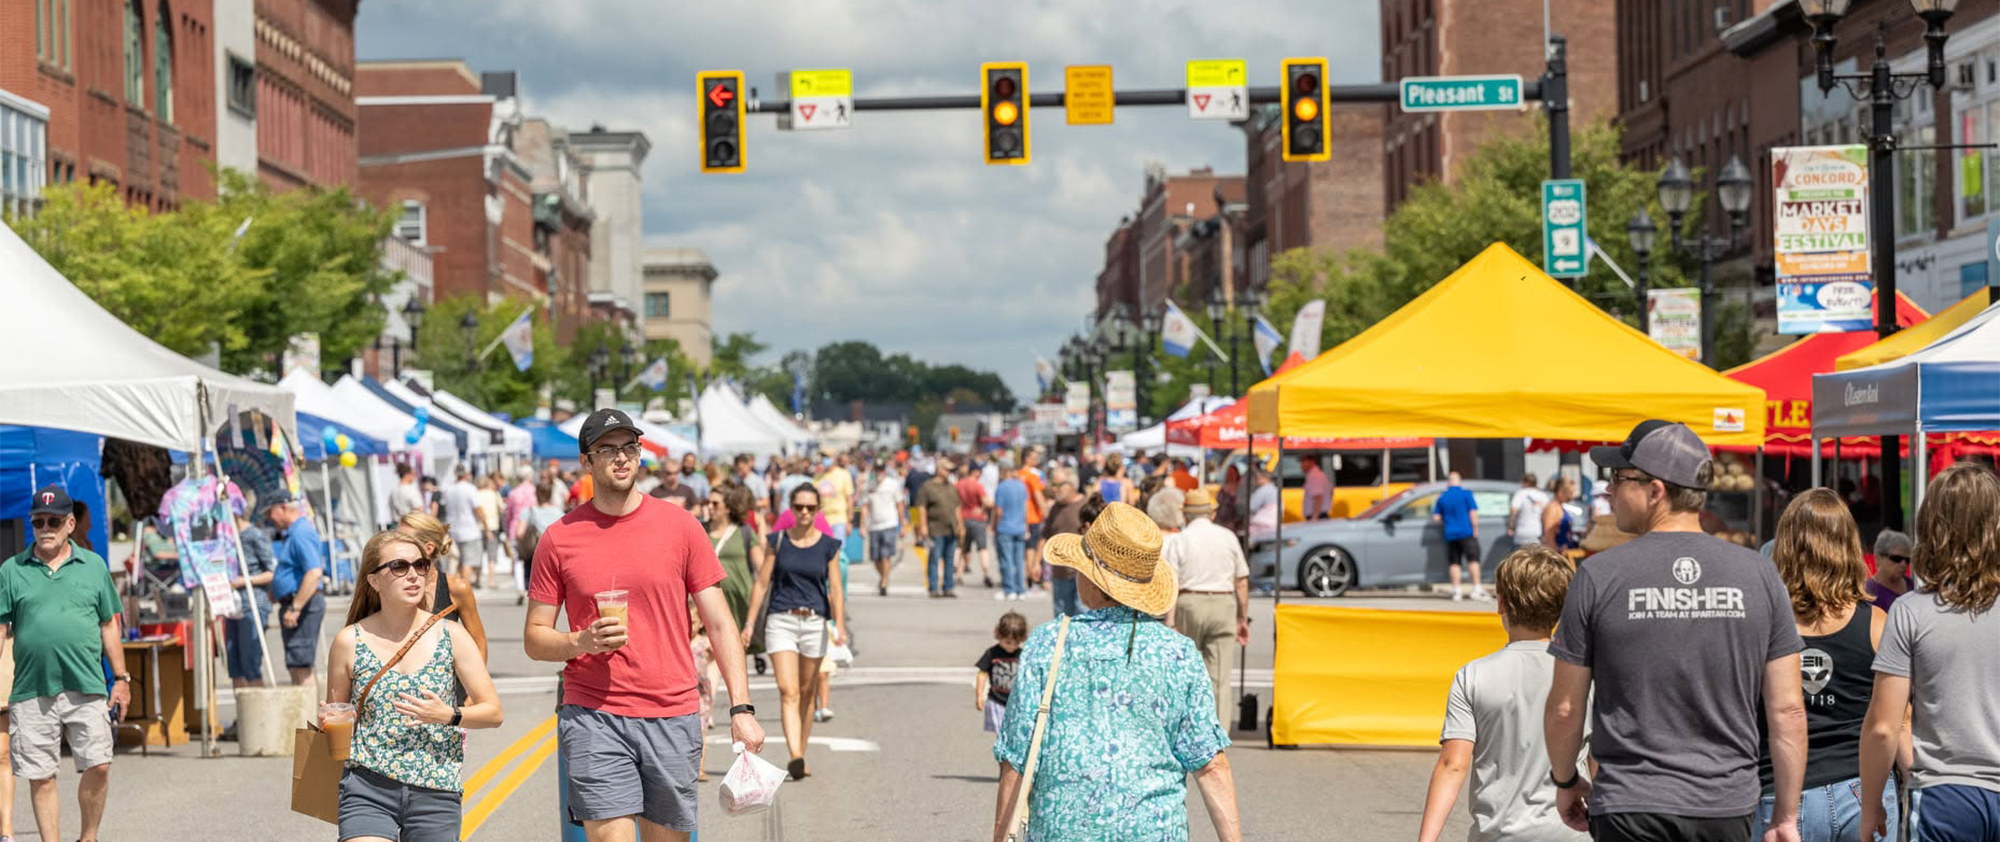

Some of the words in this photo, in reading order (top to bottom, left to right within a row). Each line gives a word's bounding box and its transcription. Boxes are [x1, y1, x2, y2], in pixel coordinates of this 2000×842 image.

[1408, 84, 1485, 105] Pleasant
[1498, 86, 1513, 103] St
[1794, 172, 1855, 185] CONCORD
[1552, 204, 1577, 218] 202
[1780, 200, 1860, 217] MARKET
[1800, 216, 1847, 232] DAYS
[1779, 233, 1866, 250] FESTIVAL
[1629, 587, 1744, 610] FINISHER
[1628, 612, 1645, 620] JOIN
[1691, 610, 1746, 618] SPARTAN.COM
